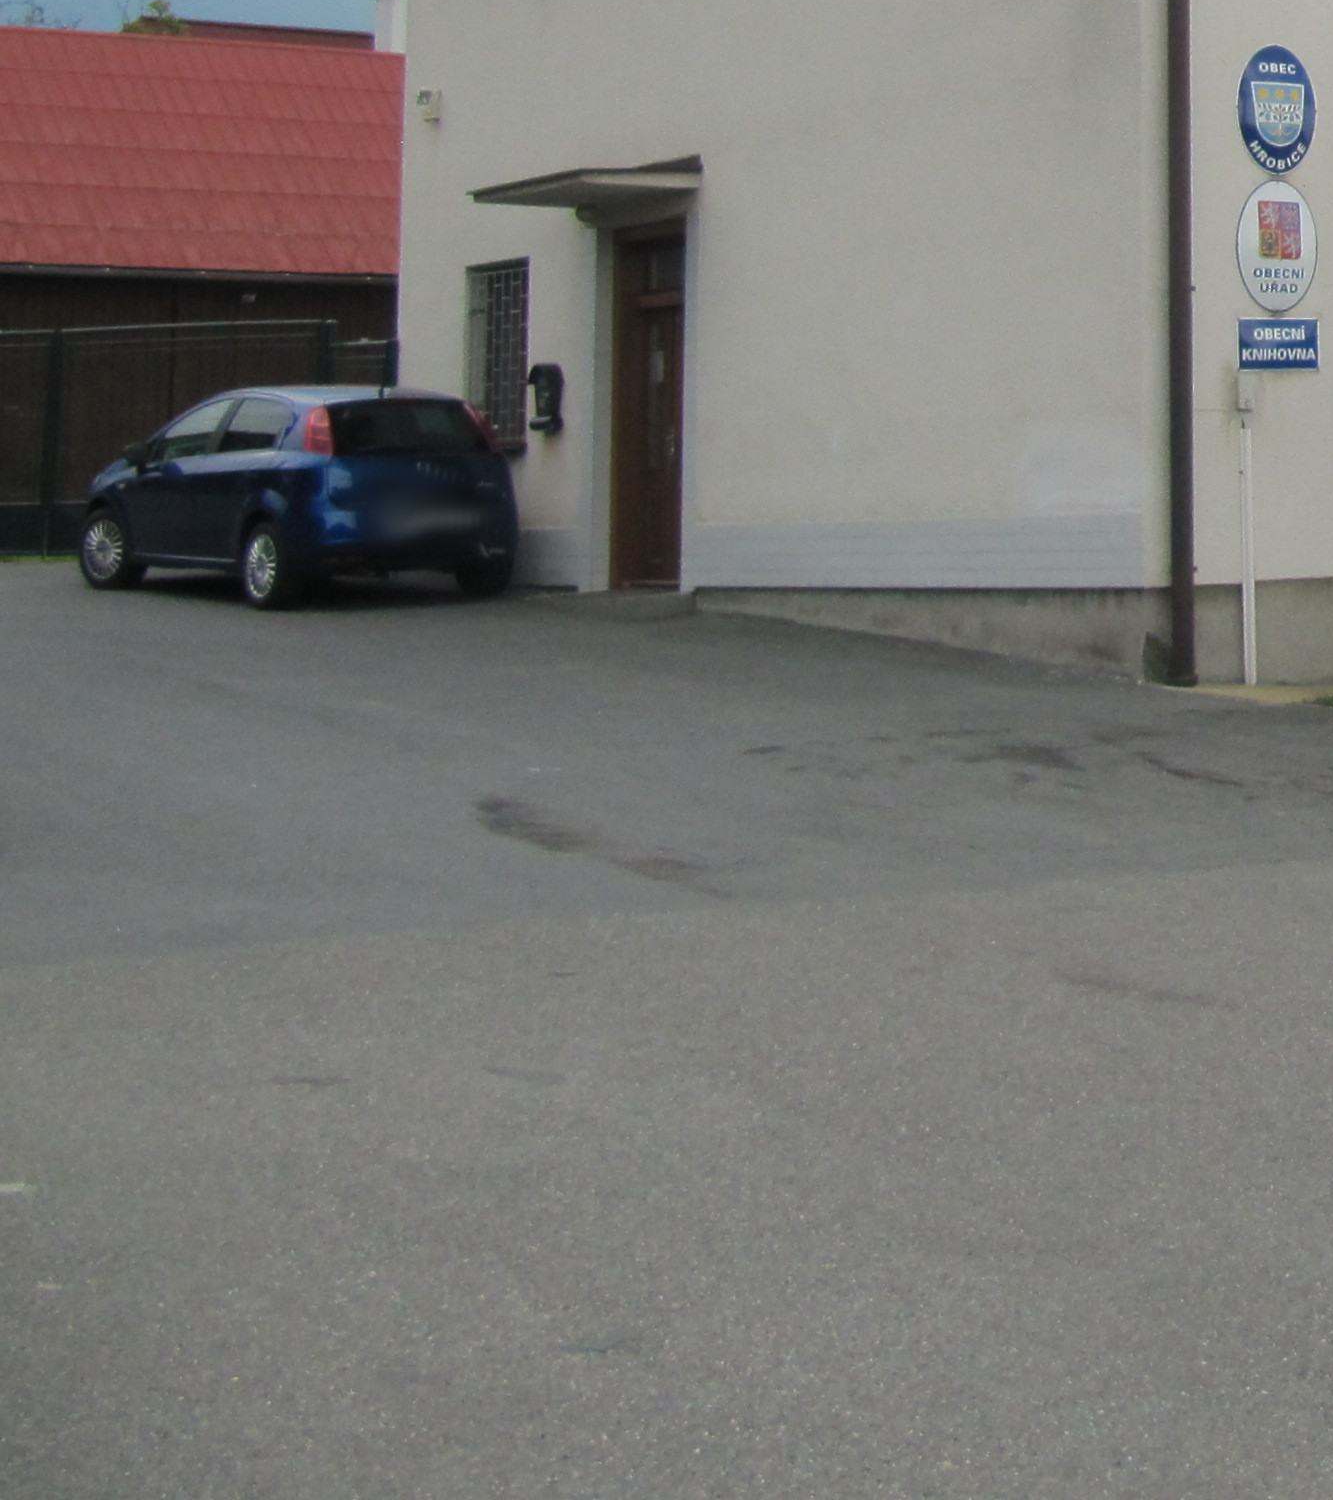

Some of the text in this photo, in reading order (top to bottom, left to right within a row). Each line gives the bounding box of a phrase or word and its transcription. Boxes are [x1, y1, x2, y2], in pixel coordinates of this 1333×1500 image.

[1258, 62, 1297, 74] OBEC
[1249, 140, 1306, 170] HROBICE
[1253, 267, 1305, 279] OBECNÍ
[1260, 280, 1299, 294] ÚŘAD
[1253, 325, 1306, 340] OBECNÍ
[1242, 348, 1316, 361] KNIHOVNA
